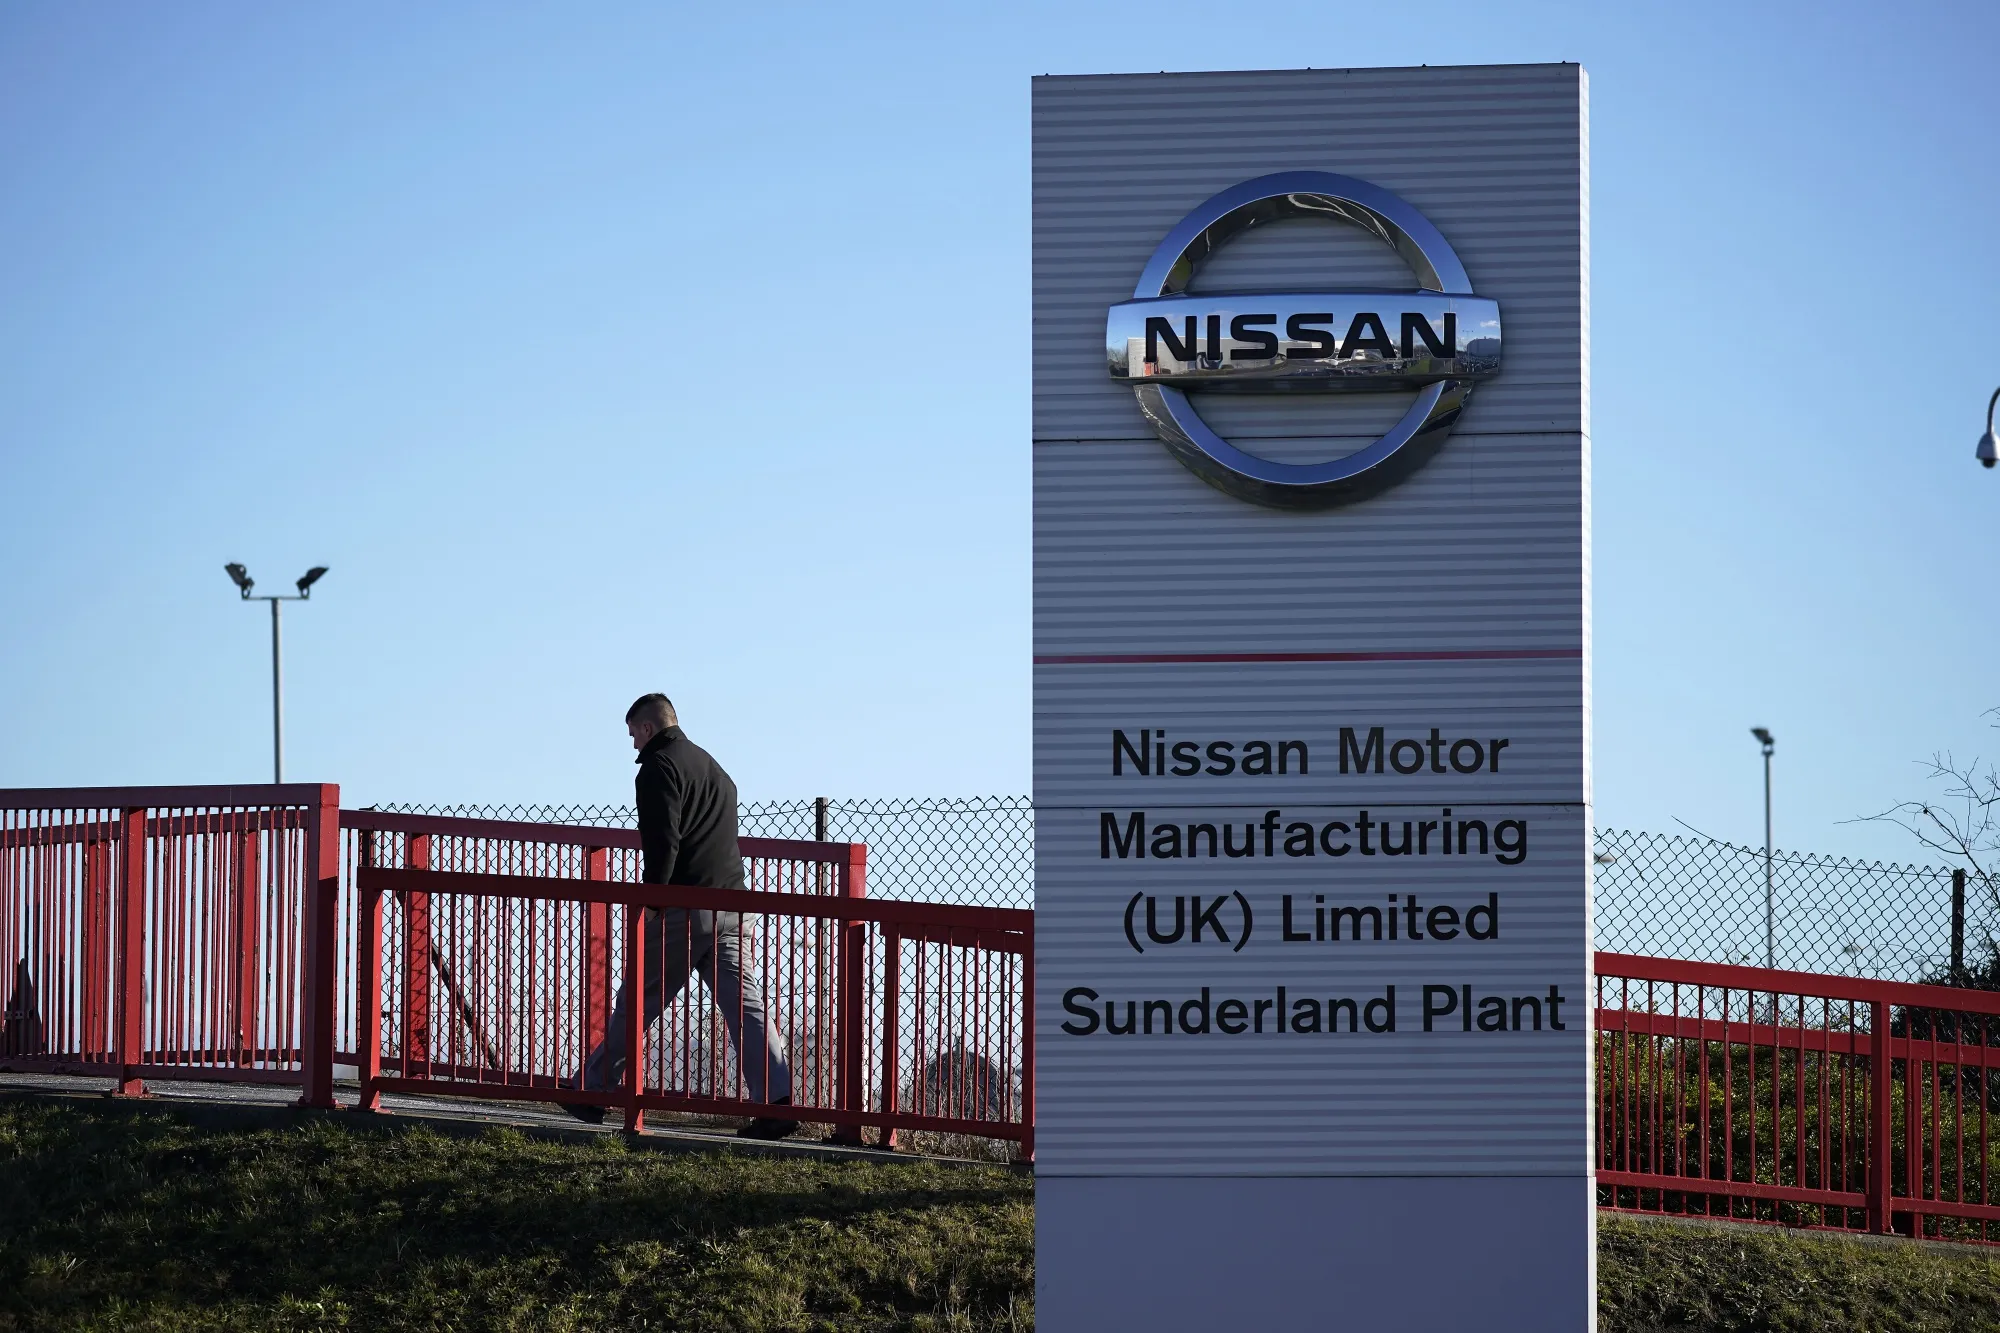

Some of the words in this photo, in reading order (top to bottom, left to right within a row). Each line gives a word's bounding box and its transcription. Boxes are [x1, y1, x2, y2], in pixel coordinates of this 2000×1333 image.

[1145, 312, 1457, 362] NISSAN
[1112, 728, 1309, 777] Nissan
[1338, 726, 1510, 776] Motor
[1100, 808, 1528, 866] Manufacturing
[1123, 889, 1253, 954] (UK)
[1281, 892, 1499, 942] Limited
[1060, 984, 1396, 1036] Sunderland
[1422, 984, 1566, 1033] Plant
